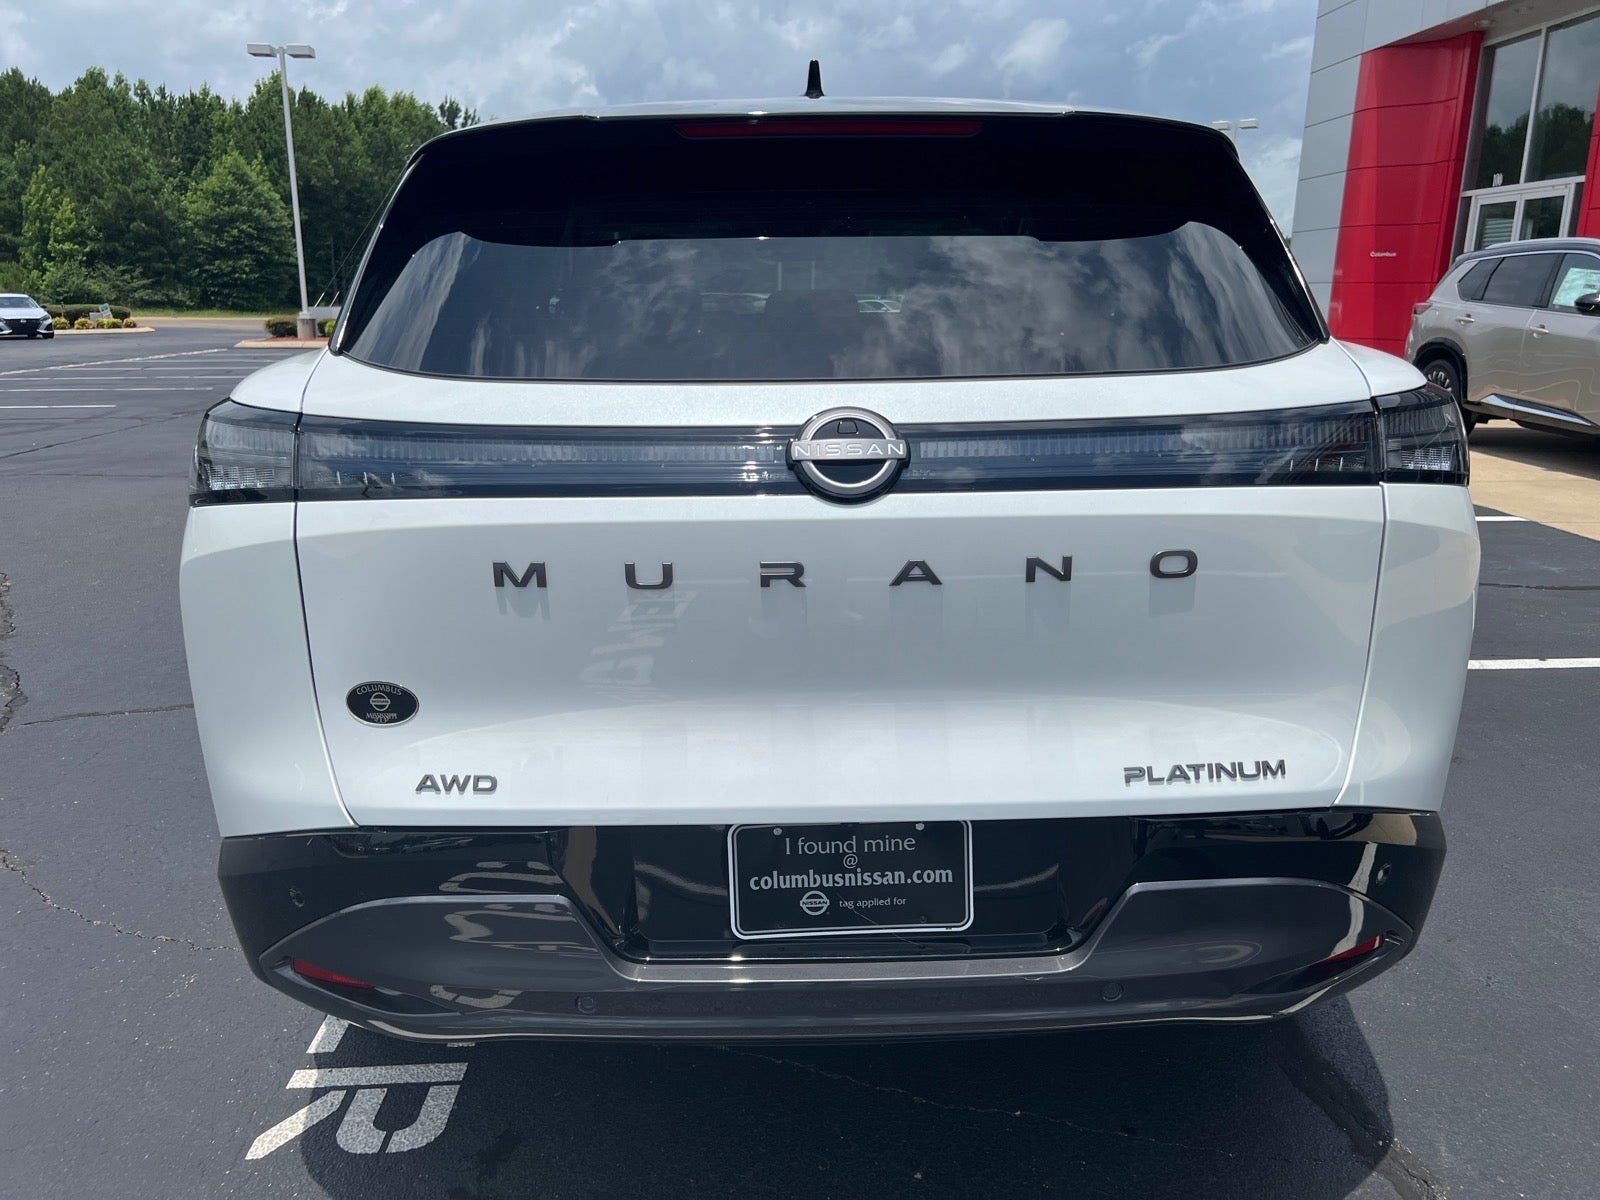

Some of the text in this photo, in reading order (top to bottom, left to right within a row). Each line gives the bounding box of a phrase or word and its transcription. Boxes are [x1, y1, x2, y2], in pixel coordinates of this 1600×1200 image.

[794, 443, 904, 457] NISSAN
[492, 549, 1199, 590] MURANO
[356, 684, 402, 695] COLUMBUS
[1123, 759, 1287, 785] PLATINUM
[415, 774, 498, 793] AWD
[785, 834, 917, 855] I found mine
[842, 853, 859, 869] @
[749, 867, 954, 891] columbusnissan.com
[801, 896, 907, 909] NISSAN tag applied for
